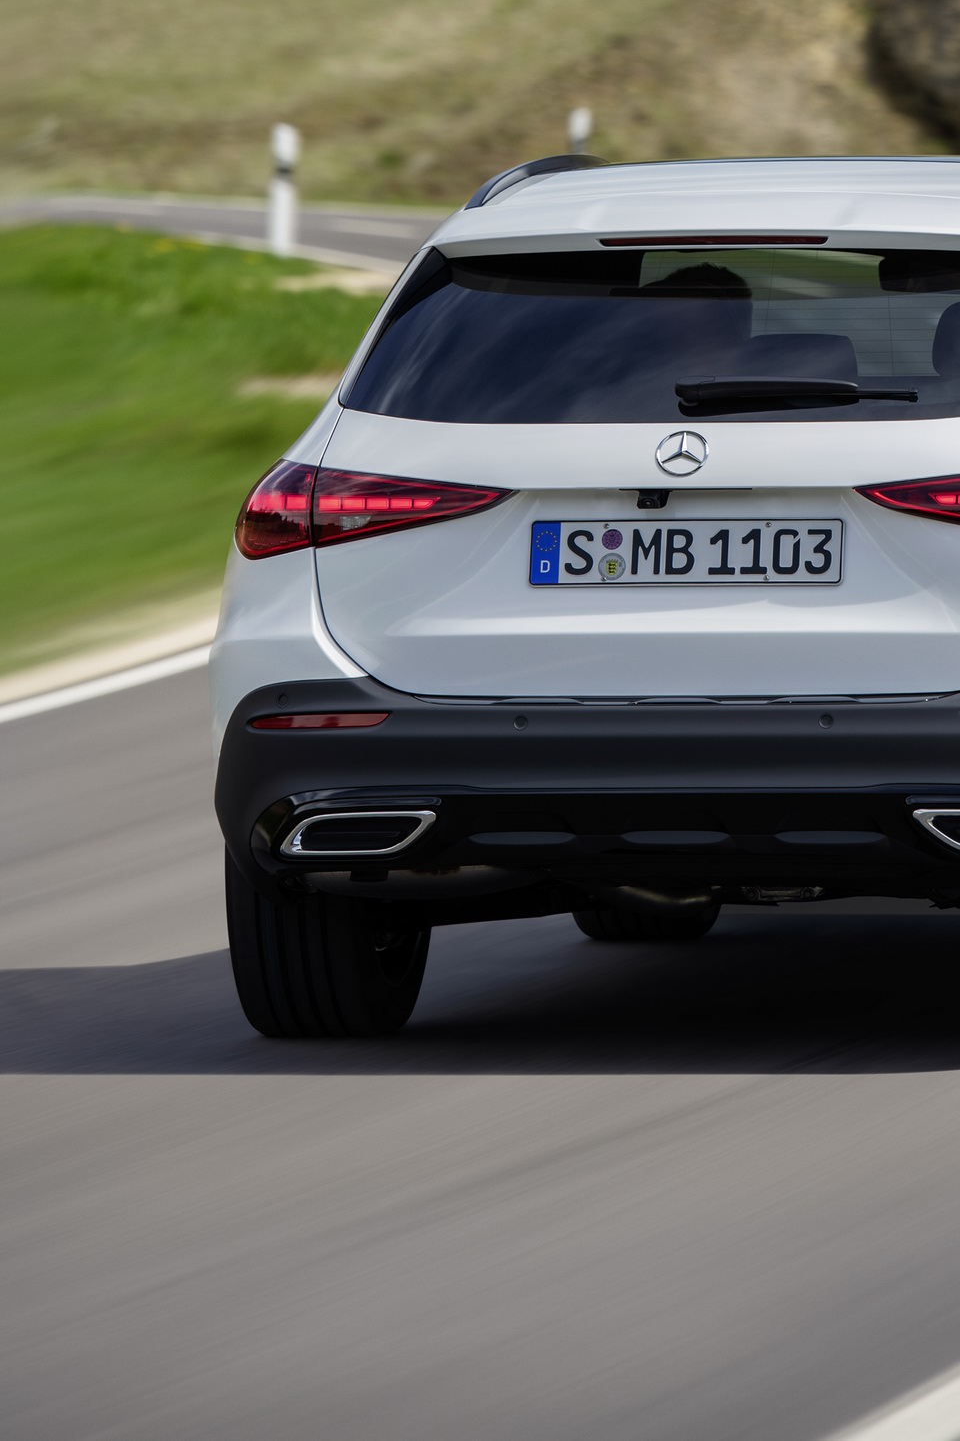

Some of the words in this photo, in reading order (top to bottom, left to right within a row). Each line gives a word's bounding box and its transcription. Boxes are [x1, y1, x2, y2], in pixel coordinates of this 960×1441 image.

[564, 529, 595, 575] S
[631, 528, 695, 575] MB
[707, 528, 833, 575] 1103
[539, 560, 551, 574] D
